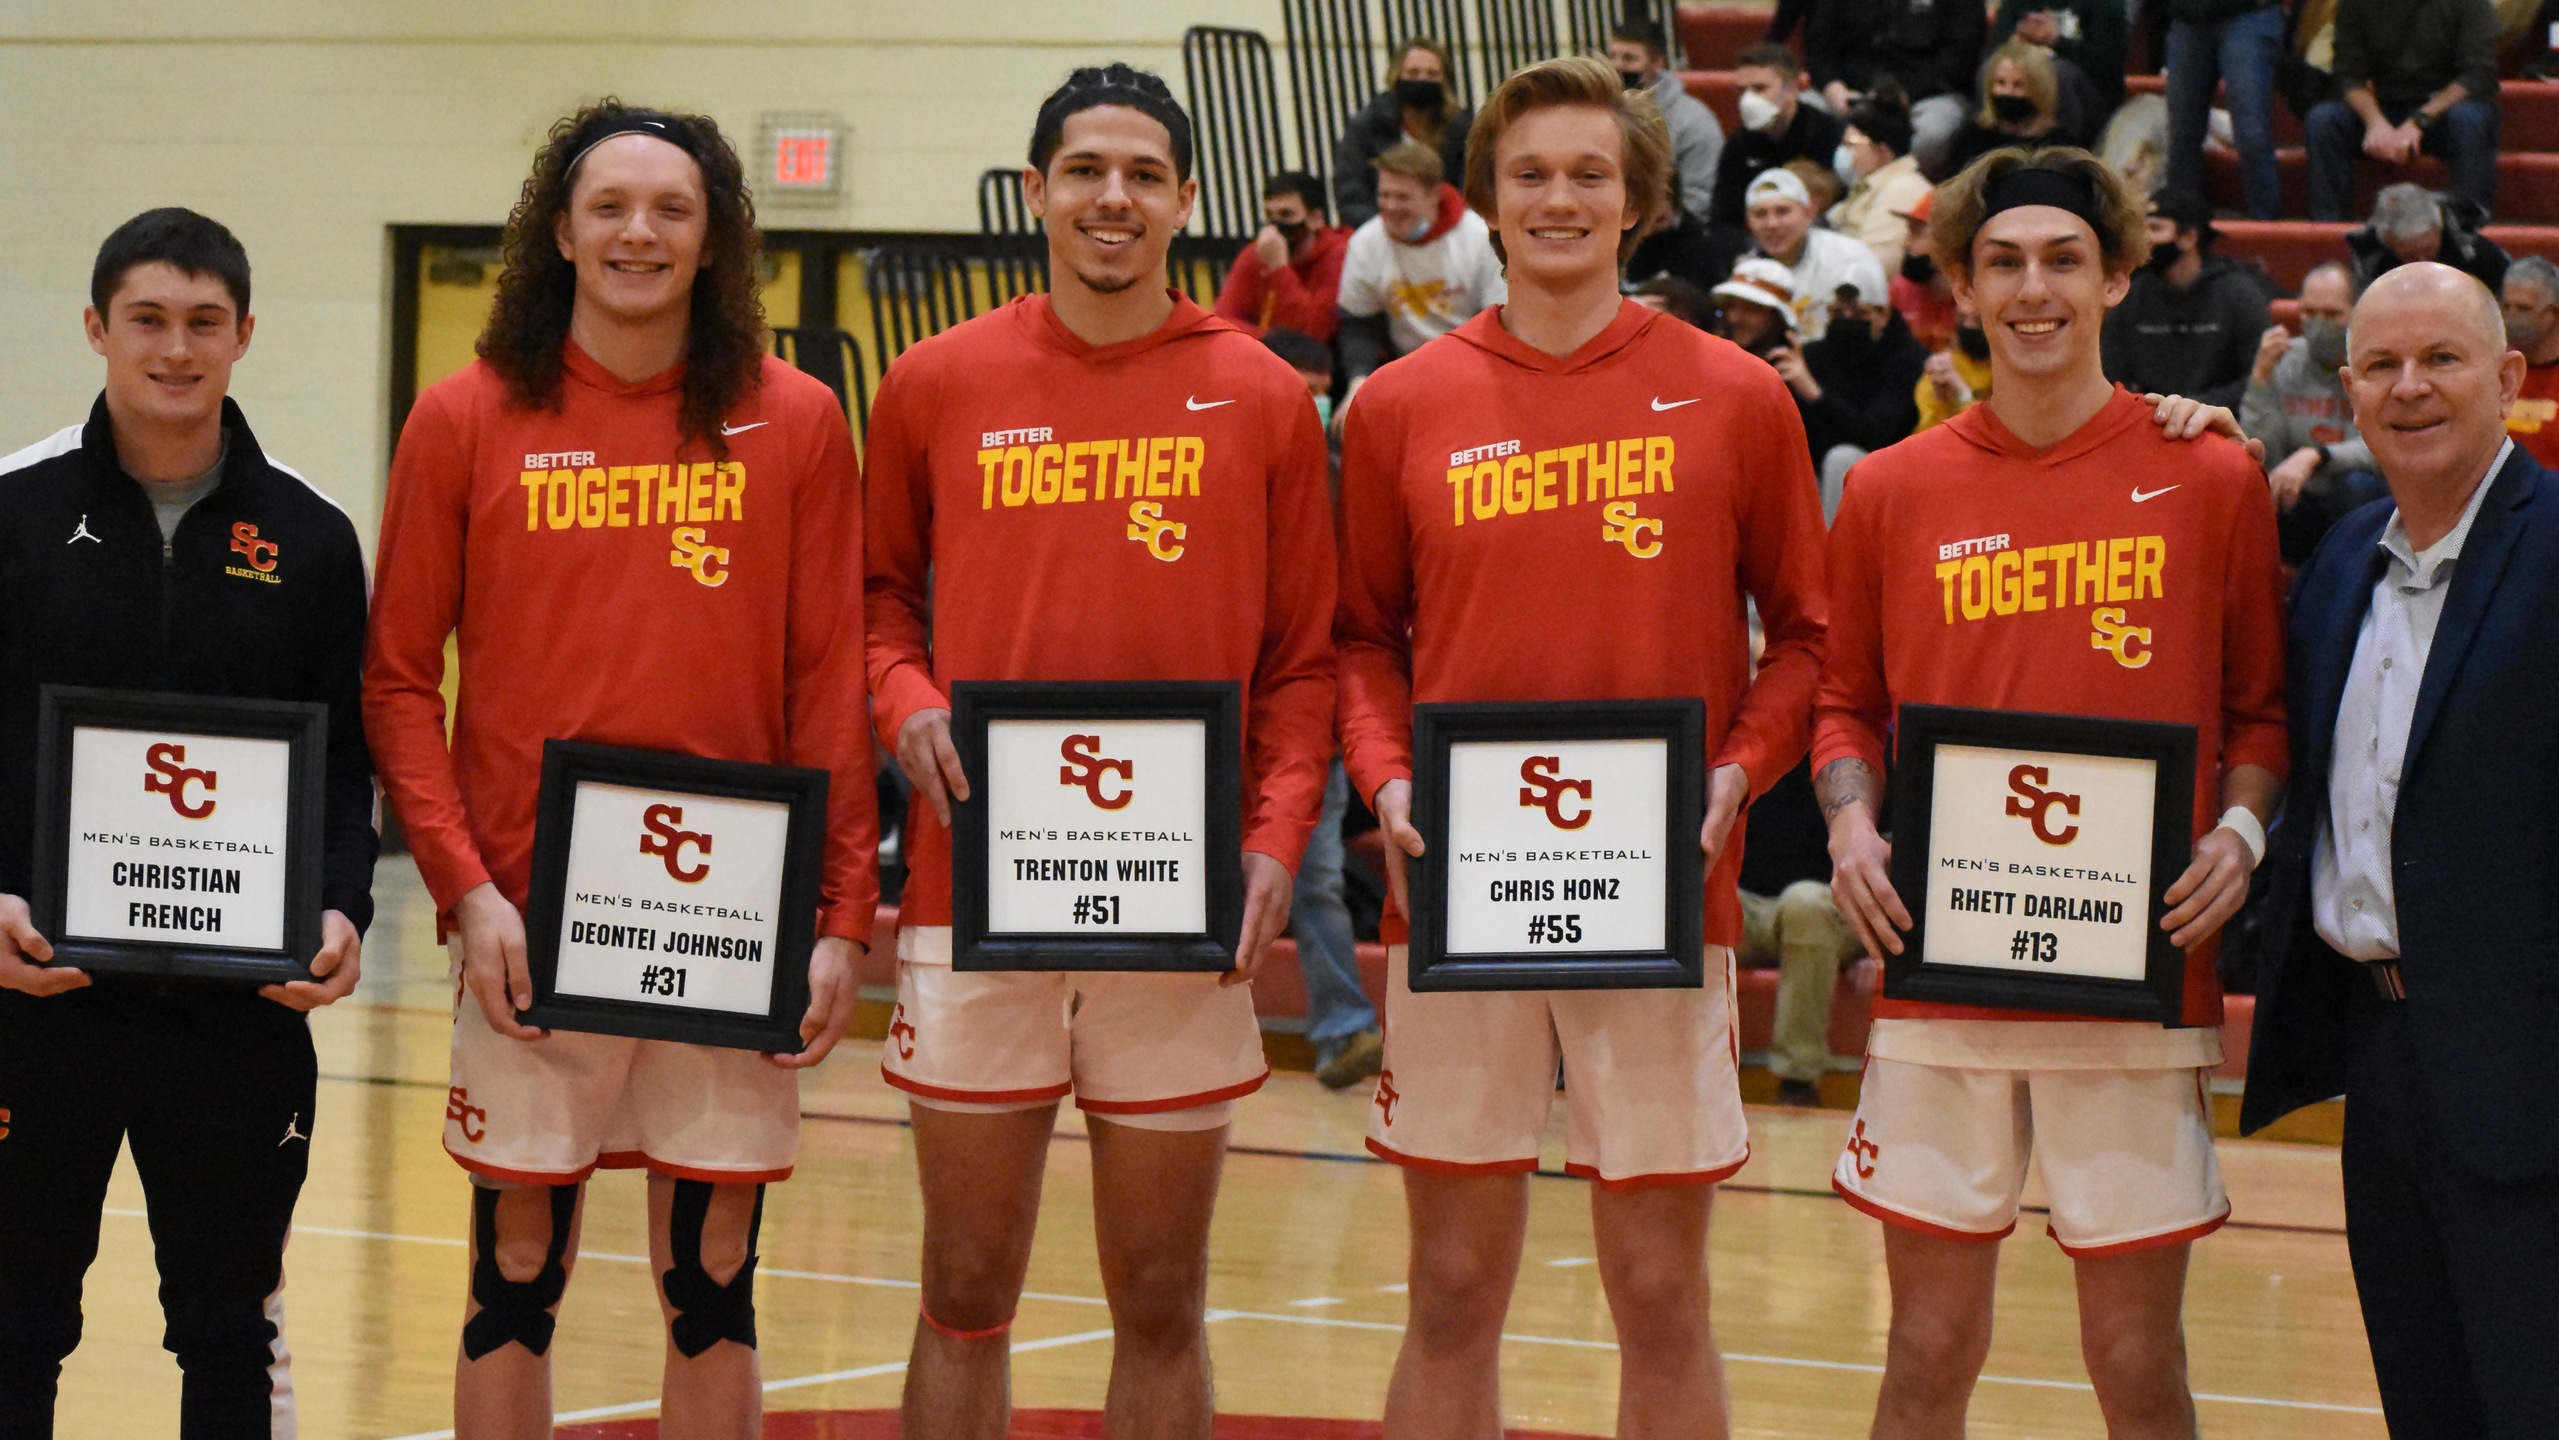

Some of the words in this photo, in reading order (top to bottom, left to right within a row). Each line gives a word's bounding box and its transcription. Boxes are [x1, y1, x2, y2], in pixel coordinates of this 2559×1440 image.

[777, 138, 828, 184] EXIT
[982, 427, 1052, 447] BETTER
[1451, 439, 1519, 466] BETTER
[525, 451, 595, 468] BETTER
[977, 437, 1204, 510] TOGETHER
[520, 461, 746, 531] TOGETHER
[1447, 436, 1674, 527] TOGETHER
[1127, 501, 1186, 562] SC
[1603, 501, 1663, 558] SC
[230, 521, 278, 573] SC
[671, 527, 729, 587] SC
[1940, 534, 2009, 560] BETTER
[225, 566, 281, 583] BASKETBALL
[1936, 536, 2165, 624] TOGETHER
[2091, 607, 2152, 668] SC
[145, 743, 217, 820] SC
[1060, 734, 1133, 811] SC
[1520, 756, 1592, 831] SC
[2006, 765, 2081, 846] SC
[84, 833, 140, 846] MEN'S
[150, 837, 274, 855] BASKETBALL
[640, 804, 713, 884] SC
[1001, 828, 1058, 841] MEN'S
[1067, 831, 1193, 842] BASKETBALL
[1014, 859, 1108, 882] TRENTON
[1117, 860, 1179, 882] WHITE
[1461, 850, 1517, 863] MEN'S
[1526, 850, 1652, 861] BASKETBALL
[1942, 858, 2000, 872] MEN'S
[2009, 864, 2137, 884] BASKETBALL
[113, 862, 241, 895] CHRISTIAN
[1491, 880, 1555, 902] CHRIS
[1564, 879, 1621, 901] HONZ
[129, 903, 222, 933] FRENCH
[576, 893, 632, 908] MEN'S
[641, 900, 764, 922] BASKETBALL
[1073, 896, 1120, 925] #51
[1951, 888, 2017, 915] RHETT
[2024, 895, 2123, 924] DARLAND
[571, 921, 656, 951] DEONTEI
[663, 932, 763, 963] JOHNSON
[1528, 915, 1582, 944] #55
[2011, 930, 2058, 963] #13
[641, 965, 687, 998] #31
[447, 1086, 486, 1144] SC
